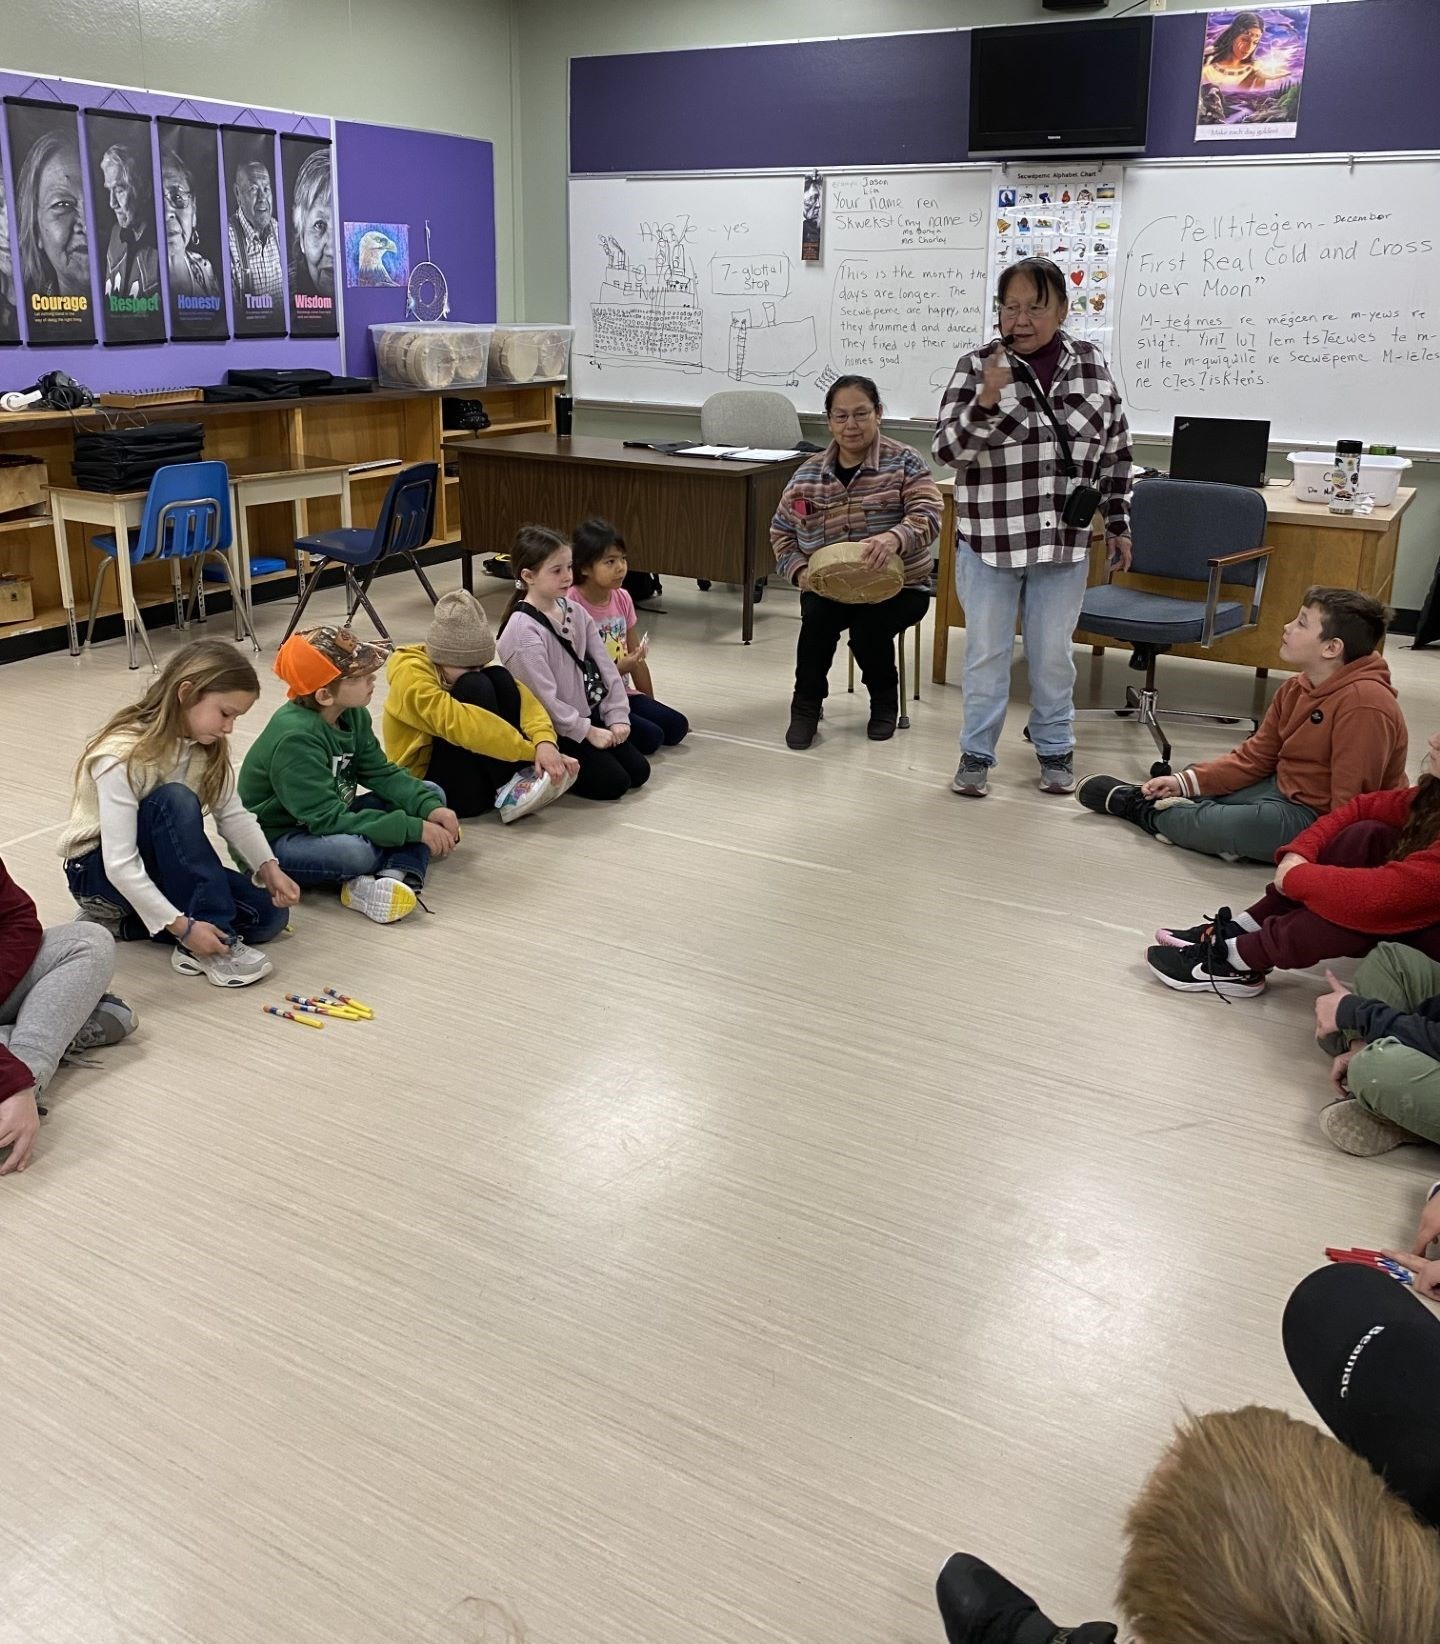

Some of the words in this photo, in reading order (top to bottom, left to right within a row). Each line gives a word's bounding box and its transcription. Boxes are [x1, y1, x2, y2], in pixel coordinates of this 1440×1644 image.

[833, 192, 859, 209] Your
[870, 197, 904, 210] name
[929, 215, 963, 227] name
[723, 222, 750, 240] yes
[1203, 248, 1254, 272] Real
[1265, 243, 1307, 266] Cold
[1320, 240, 1358, 260] and
[1369, 237, 1433, 257] Cross
[840, 265, 868, 280] This
[876, 269, 886, 279] is
[894, 265, 914, 278] the
[923, 267, 963, 279] month
[839, 286, 868, 301] days
[874, 288, 894, 299] are
[949, 286, 967, 297] The
[1137, 282, 1189, 298] over
[31, 293, 88, 312] Courage
[109, 293, 159, 312] Respect
[177, 294, 220, 311] Honesty
[245, 293, 273, 309] Truth
[294, 294, 332, 309] Wisdom
[840, 321, 863, 334] they
[921, 321, 940, 332] and
[840, 338, 866, 351] They
